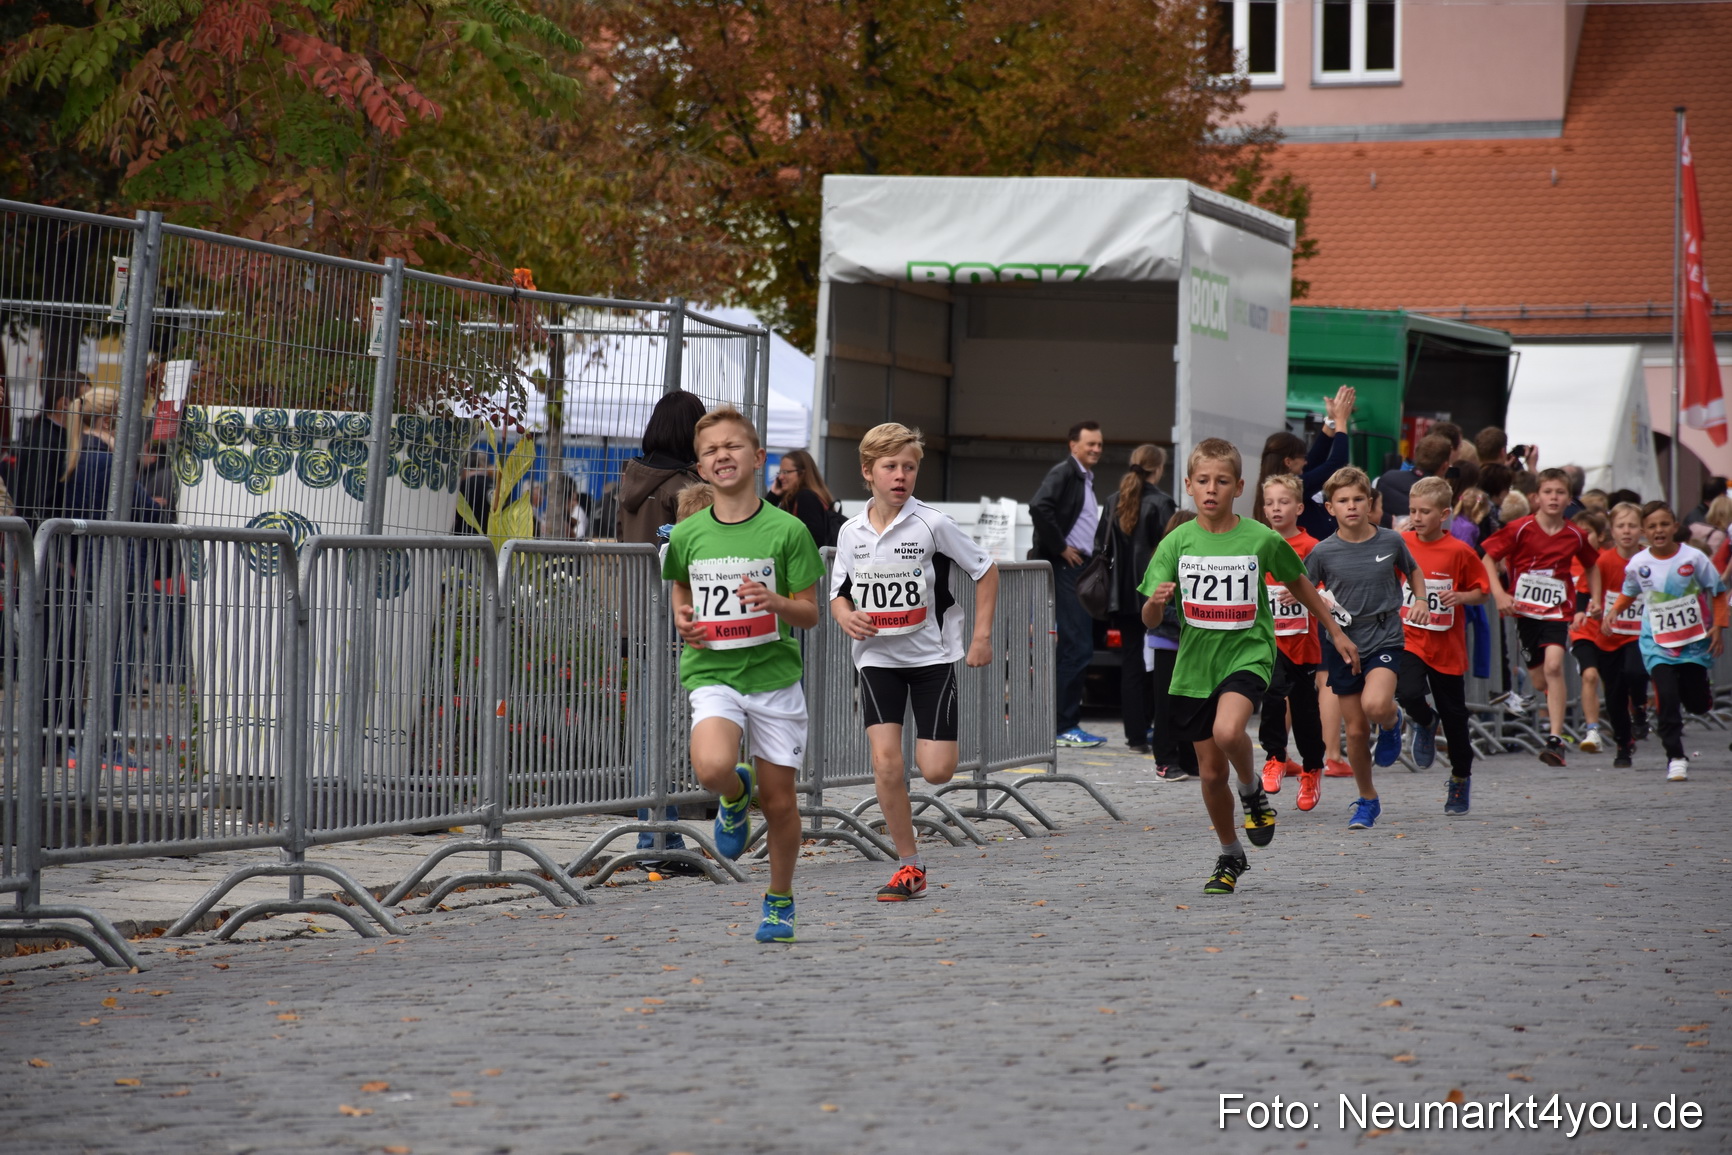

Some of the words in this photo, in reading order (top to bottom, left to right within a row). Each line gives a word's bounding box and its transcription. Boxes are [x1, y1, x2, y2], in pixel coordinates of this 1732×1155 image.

[1190, 272, 1228, 336] BOCK
[853, 552, 870, 560] Vincent
[894, 547, 925, 555] MÜNCH
[1180, 562, 1206, 571] PARTL
[1207, 563, 1246, 571] Neumarkt
[690, 573, 714, 581] PARTL
[716, 570, 760, 580] Neumrkt
[874, 571, 911, 579] Neumarkt
[1186, 574, 1249, 602] 7211
[698, 581, 768, 617] 721
[856, 581, 921, 609] 7028
[1522, 584, 1562, 606] 7005
[1191, 606, 1248, 619] Maximilian
[1655, 607, 1698, 631] 7413
[871, 614, 910, 627] Vincent
[715, 624, 752, 637] Kenny
